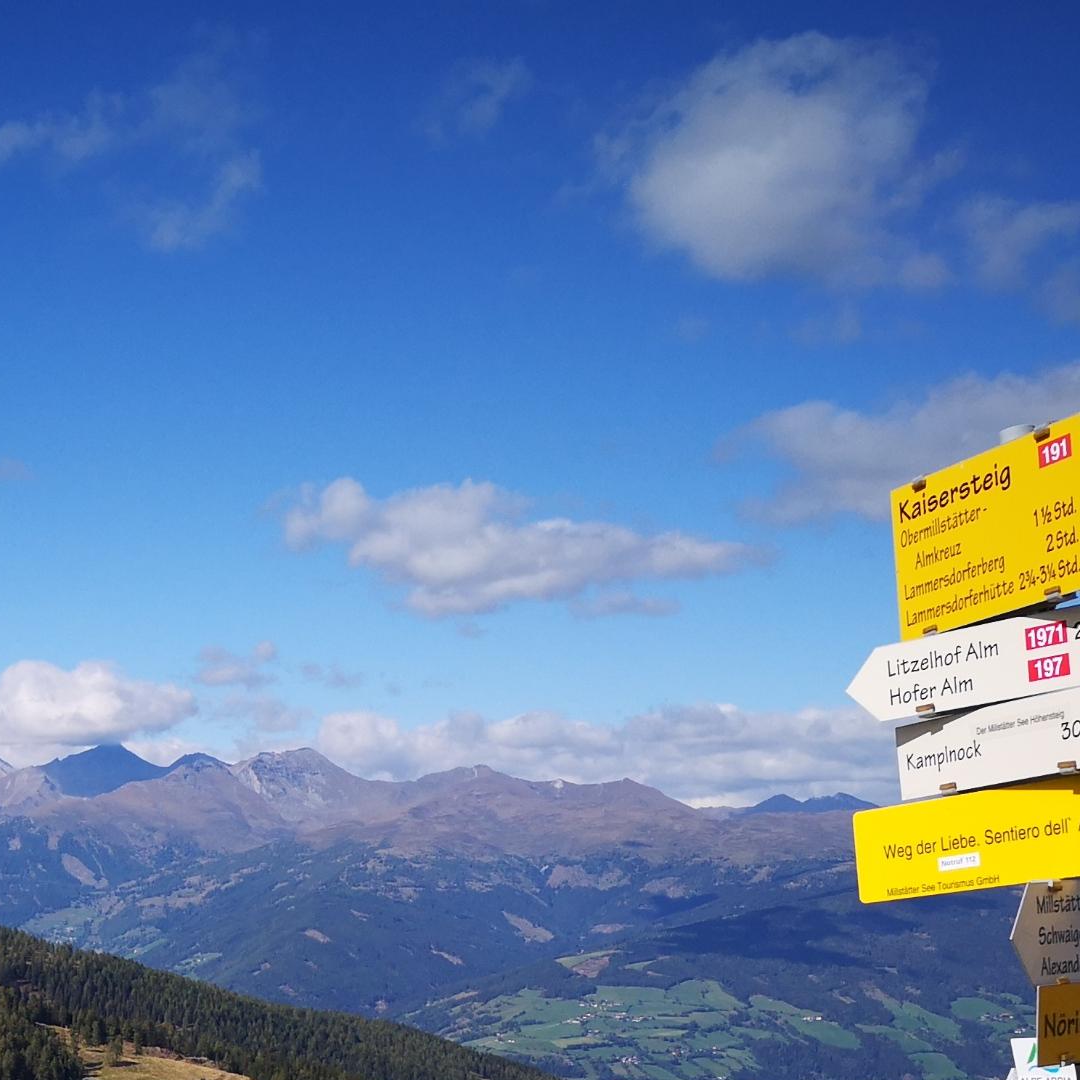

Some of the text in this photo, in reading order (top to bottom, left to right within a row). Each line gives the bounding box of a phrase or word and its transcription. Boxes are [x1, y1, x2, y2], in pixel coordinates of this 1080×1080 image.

[1042, 438, 1069, 465] 191
[899, 463, 1011, 523] Kaisersteig
[1054, 496, 1077, 520] Std.
[1046, 525, 1079, 552] 2 Std.
[915, 542, 962, 570] Almkreuz
[904, 555, 1005, 600] Lammersdorferberg
[906, 580, 1015, 626] Lammersdorferhütte
[1028, 623, 1064, 648] 1971
[887, 641, 999, 677] Litzelhof Alm
[1034, 656, 1063, 679] 197
[889, 676, 974, 706] Hofer Alm
[906, 739, 982, 772] Kamplnock
[883, 844, 913, 860] Weg
[916, 841, 936, 855] der
[984, 825, 1040, 845] Sentiero
[921, 883, 936, 893] See
[938, 879, 974, 890] Tourismus
[976, 874, 1000, 886] GmbH
